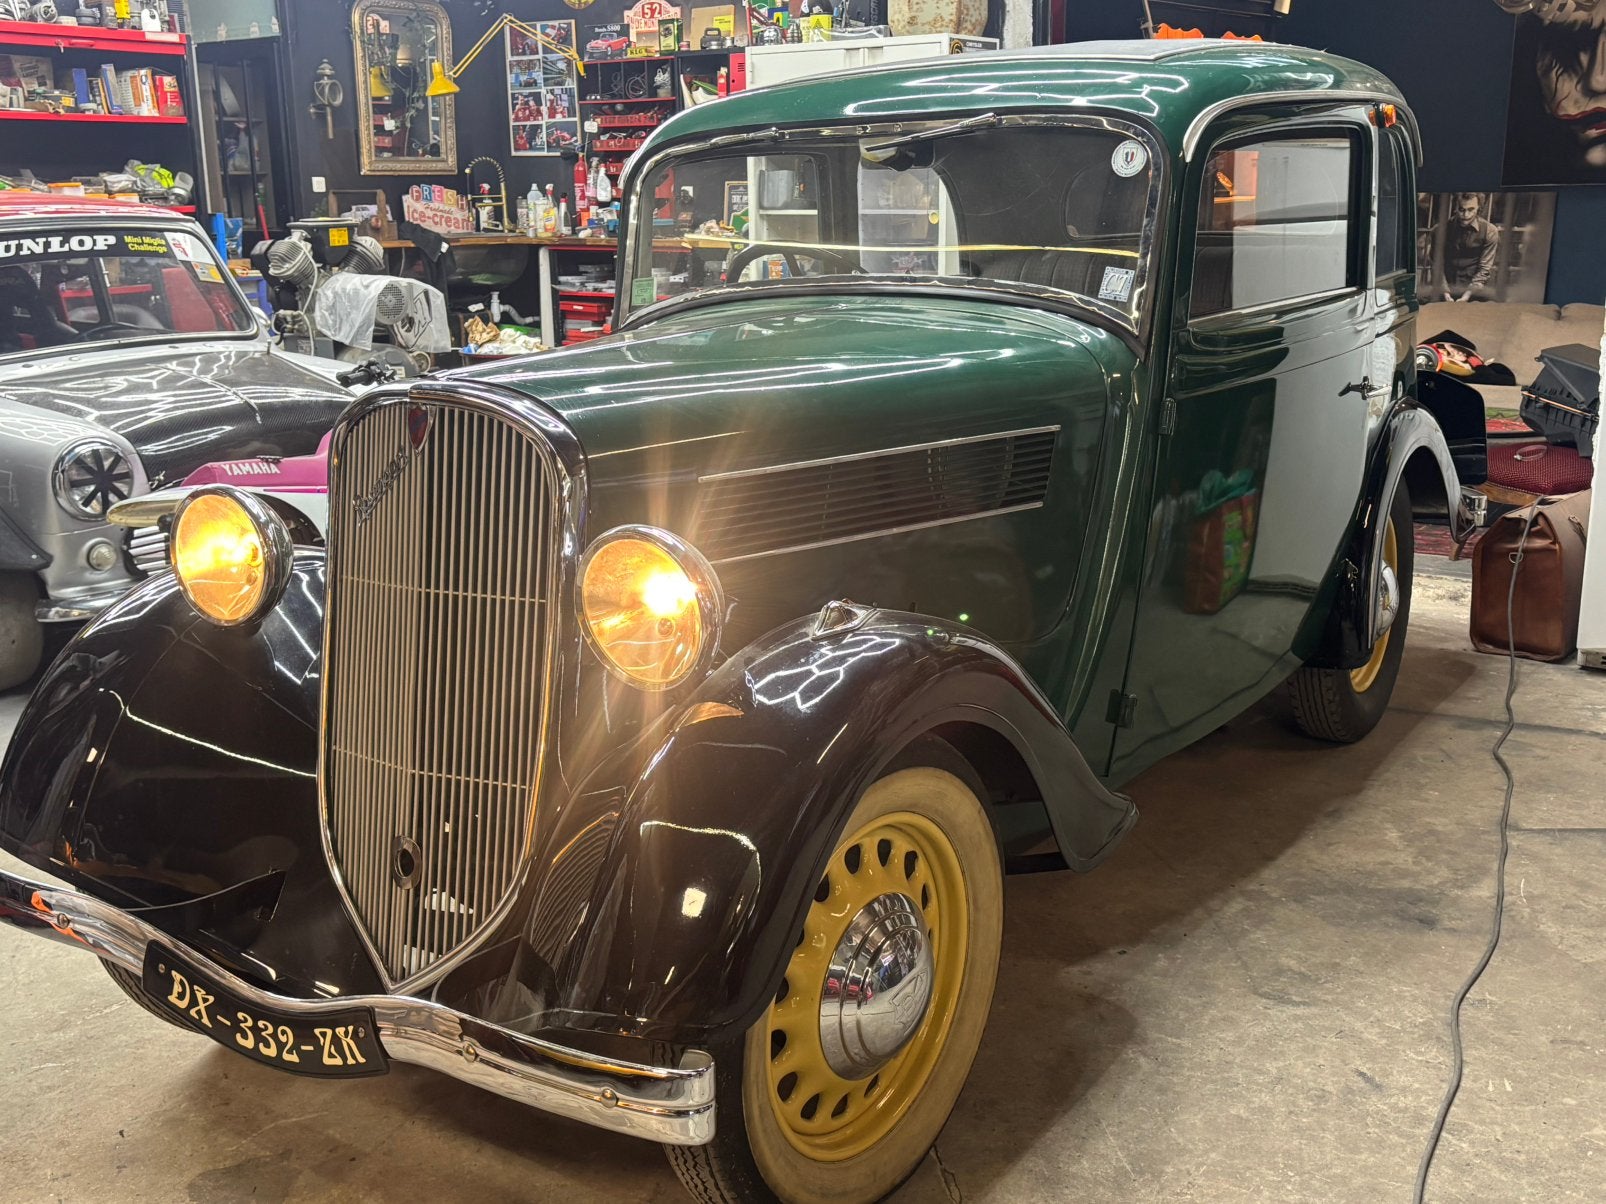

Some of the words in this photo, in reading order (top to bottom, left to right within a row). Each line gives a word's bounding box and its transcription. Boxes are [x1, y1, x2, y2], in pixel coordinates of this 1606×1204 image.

[643, 3, 661, 18] 52
[607, 24, 621, 32] S800
[411, 185, 467, 209] FRESH
[406, 204, 475, 231] Ice-cream
[0, 235, 117, 258] UNLOP
[124, 235, 142, 244] Mini
[128, 243, 168, 254] Challenge
[220, 462, 281, 476] YAMAHA
[167, 969, 366, 1066] DX-332-ZK
